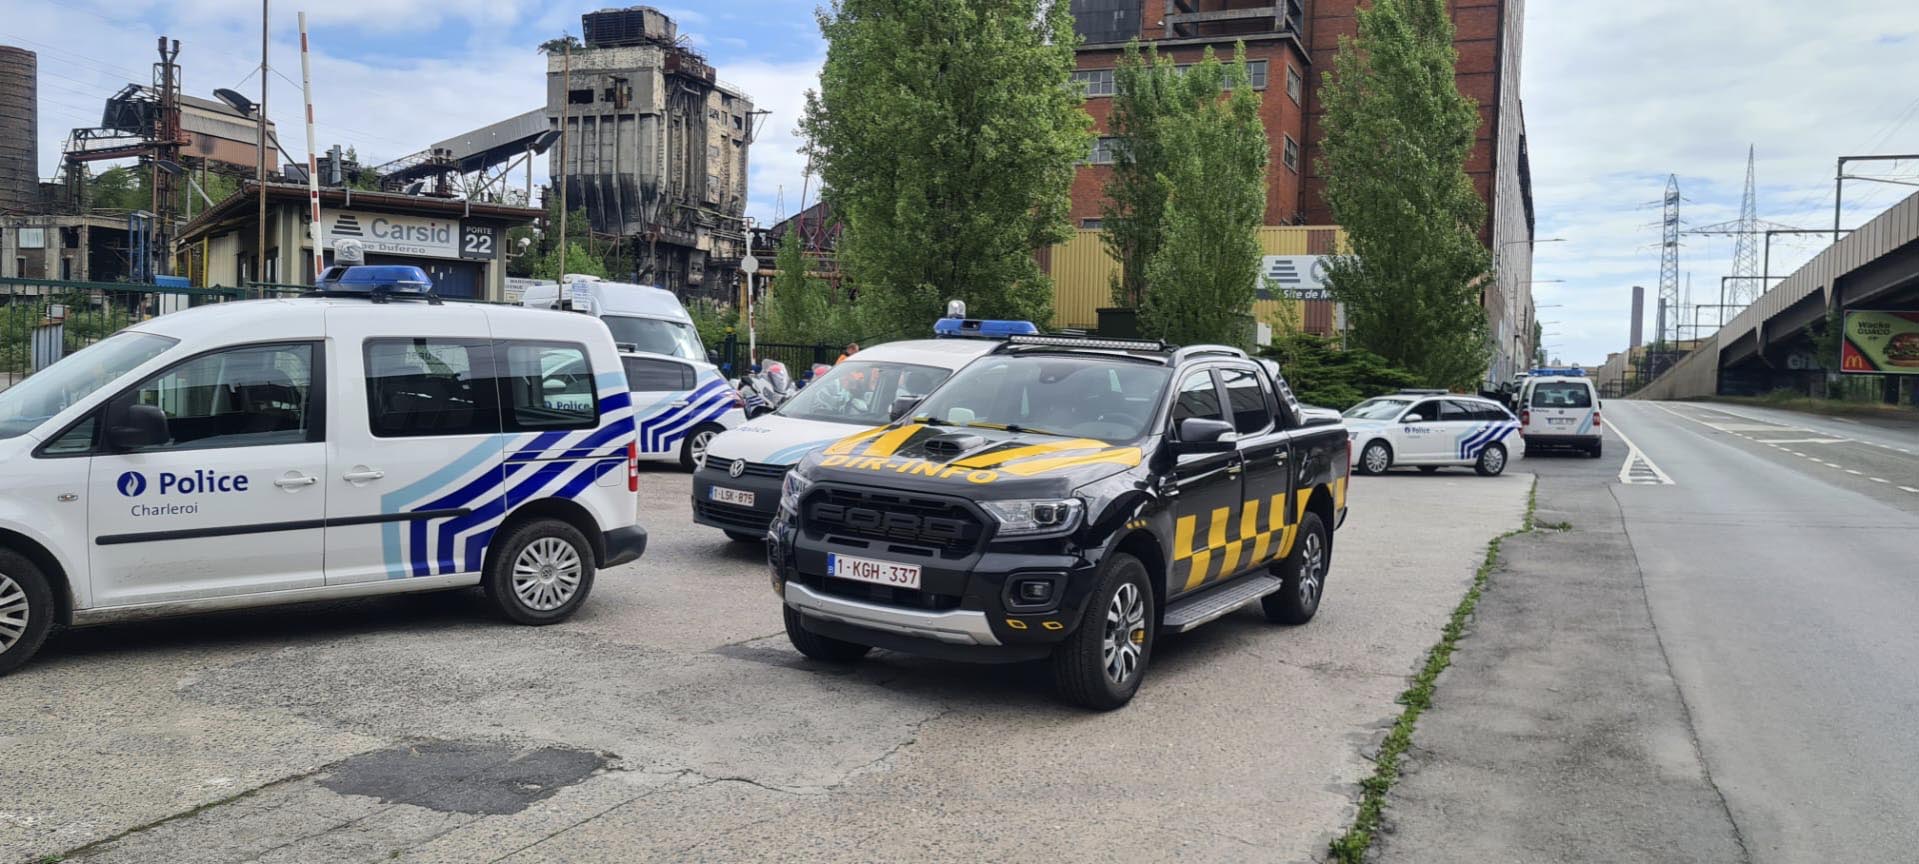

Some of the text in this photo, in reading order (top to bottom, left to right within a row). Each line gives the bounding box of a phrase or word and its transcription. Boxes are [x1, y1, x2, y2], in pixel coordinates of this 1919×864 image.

[371, 217, 450, 244] Carsid
[466, 226, 493, 235] PORTE
[378, 243, 426, 254] Duferco
[465, 234, 492, 253] 22
[1283, 289, 1303, 299] Site
[1304, 289, 1319, 299] de
[818, 455, 999, 484] DIR-INFO
[159, 469, 249, 495] Police
[131, 502, 198, 517] Charleroi
[811, 502, 967, 540] FORD
[838, 558, 918, 584] 1-KGH-337
